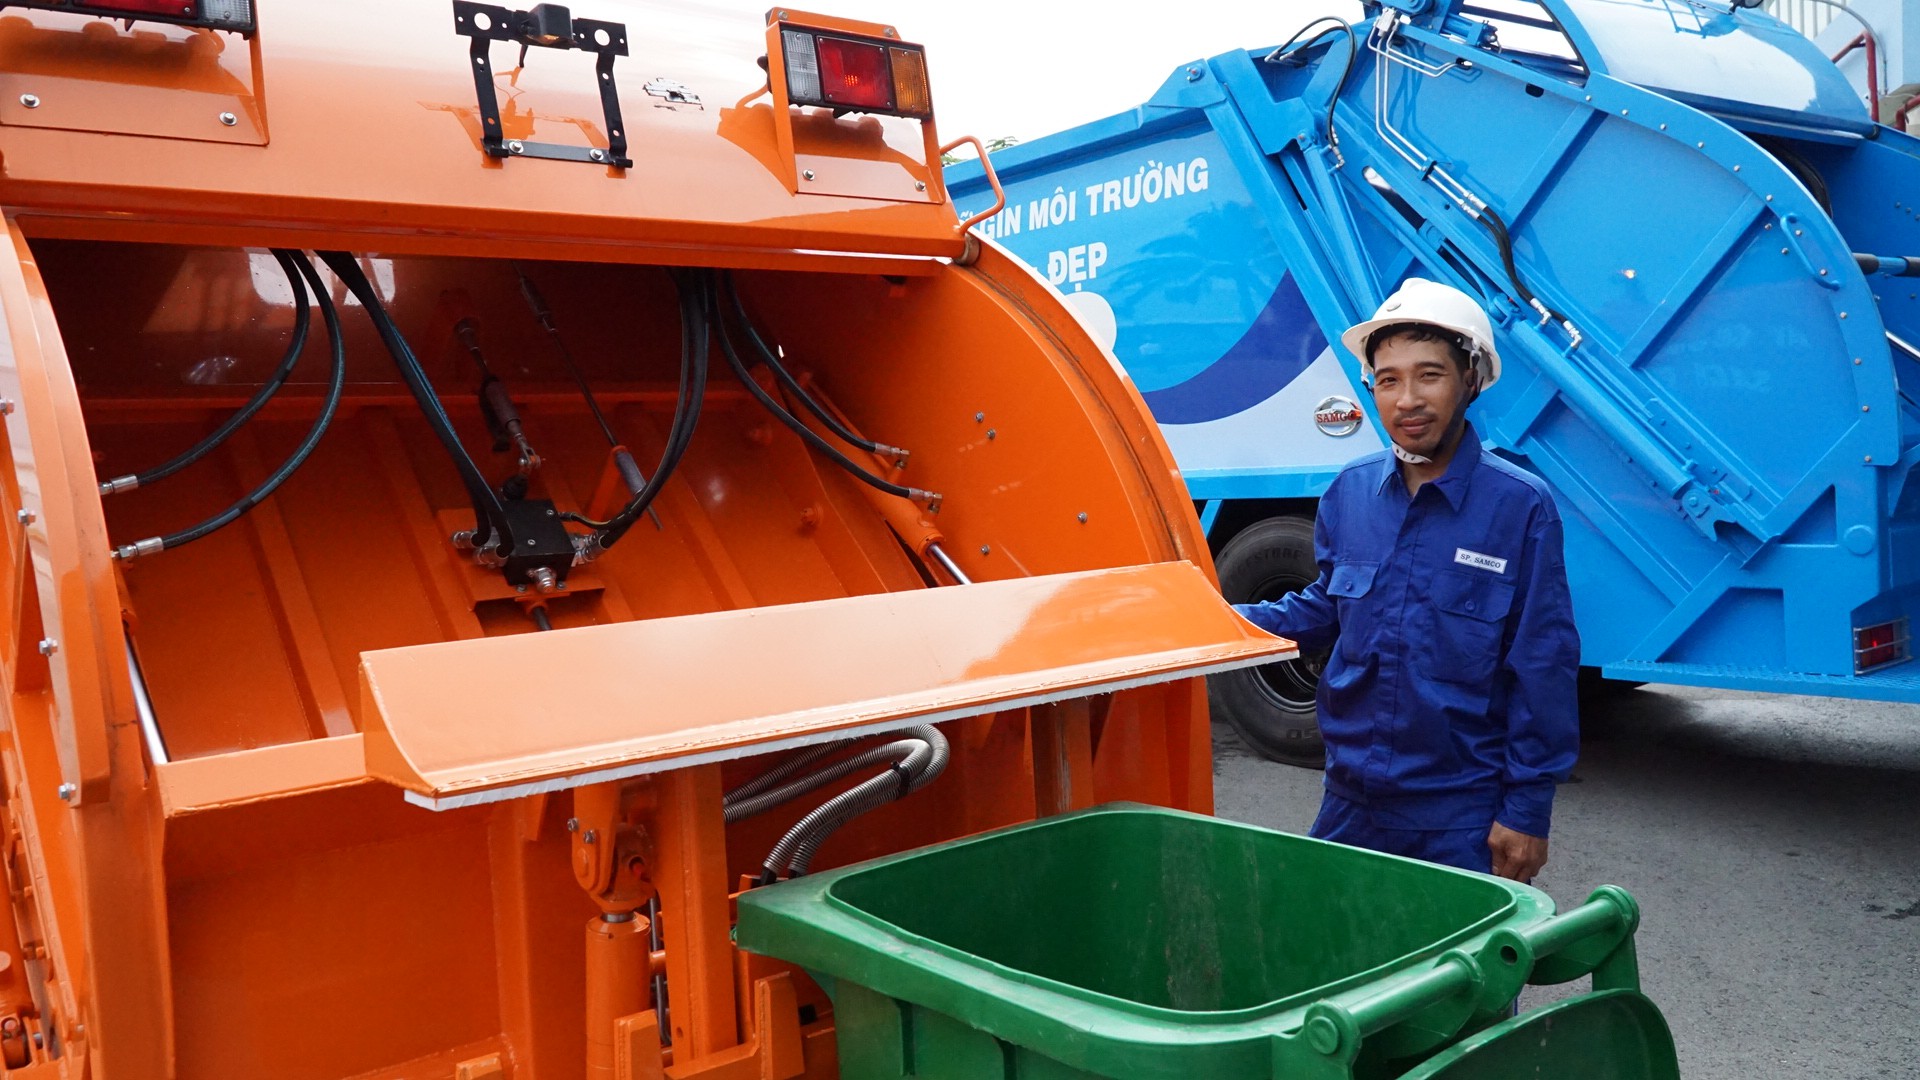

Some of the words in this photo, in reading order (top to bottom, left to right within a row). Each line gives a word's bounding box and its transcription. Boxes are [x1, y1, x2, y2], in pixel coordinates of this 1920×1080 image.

[1028, 186, 1076, 231] MÔI
[1085, 157, 1209, 216] TRƯỜNG
[1047, 241, 1108, 291] ĐẸP
[1475, 557, 1501, 568] SAMCO
